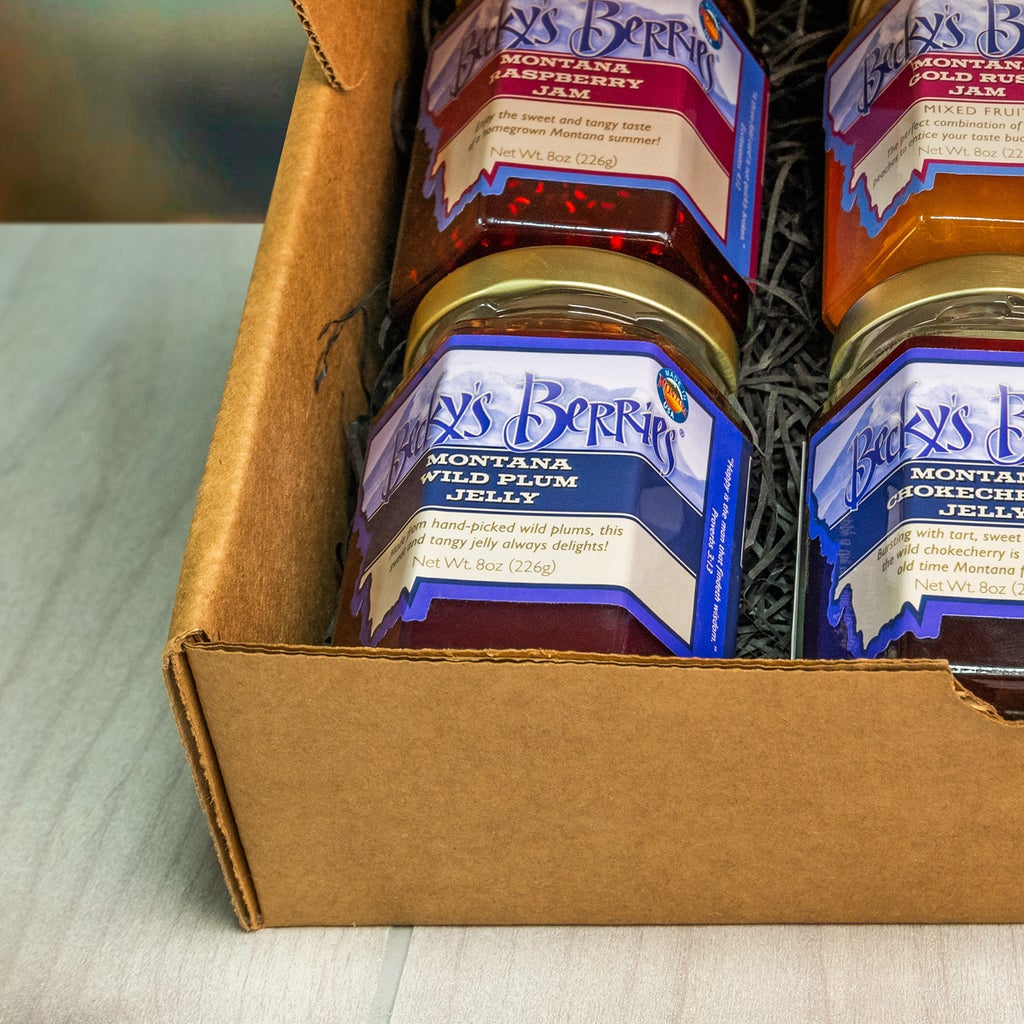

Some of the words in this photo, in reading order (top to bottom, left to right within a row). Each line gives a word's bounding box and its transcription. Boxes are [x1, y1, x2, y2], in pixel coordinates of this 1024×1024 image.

[500, 54, 630, 74] MONTANA
[490, 68, 643, 89] RASPBERRY
[909, 71, 972, 87] GOLD
[533, 86, 591, 99] JAM
[949, 86, 1006, 97] JAM
[924, 105, 976, 115] MIXED
[498, 110, 517, 120] the
[521, 113, 555, 123] sweet
[560, 116, 582, 126] and
[586, 120, 618, 130] tangy
[622, 122, 651, 131] taste
[933, 119, 1005, 129] combination
[1010, 120, 1022, 131] of
[550, 128, 604, 141] Montana
[608, 135, 661, 145] summer!
[942, 132, 967, 144] your
[971, 132, 1000, 142] taste
[490, 147, 515, 158] Net
[520, 149, 543, 160] Wt.
[547, 152, 570, 163] 8oz
[576, 153, 618, 169] (226g)
[918, 145, 942, 156] Net
[946, 146, 971, 157] Wt.
[974, 147, 997, 157] 8oz
[503, 372, 676, 475] Berries
[844, 381, 973, 510] Becky's
[425, 453, 572, 470] MONTANA
[420, 471, 489, 484] WILD
[497, 474, 578, 488] PLUM
[446, 489, 540, 504] JELLY
[723, 492, 730, 502] is
[720, 502, 730, 519] the
[431, 518, 515, 533] hand-picked
[519, 523, 547, 534] wild
[550, 525, 595, 537] plums,
[599, 525, 624, 536] this
[706, 507, 721, 549] Proverbs
[718, 520, 727, 542] man
[430, 536, 467, 550] tangy
[469, 537, 498, 551] jelly
[502, 539, 547, 551] always
[552, 540, 609, 554] delights!
[877, 530, 911, 560] Bursting
[916, 529, 944, 538] with
[949, 531, 977, 542] tart,
[983, 533, 1021, 543] sweet
[704, 550, 715, 574] 3:13
[716, 544, 726, 565] that
[882, 557, 894, 572] the
[897, 544, 918, 559] wild
[924, 545, 1005, 560] chokecherry
[1010, 548, 1019, 559] is
[412, 555, 440, 569] Net
[444, 557, 471, 570] Wt.
[476, 560, 503, 571] 8oz
[509, 559, 556, 576] (226g)
[897, 560, 913, 575] old
[919, 561, 949, 572] time
[954, 564, 1015, 575] Montana
[711, 564, 725, 602] findeth
[915, 579, 944, 591] Net
[948, 581, 975, 593] Wt.
[979, 582, 1006, 594] 8oz
